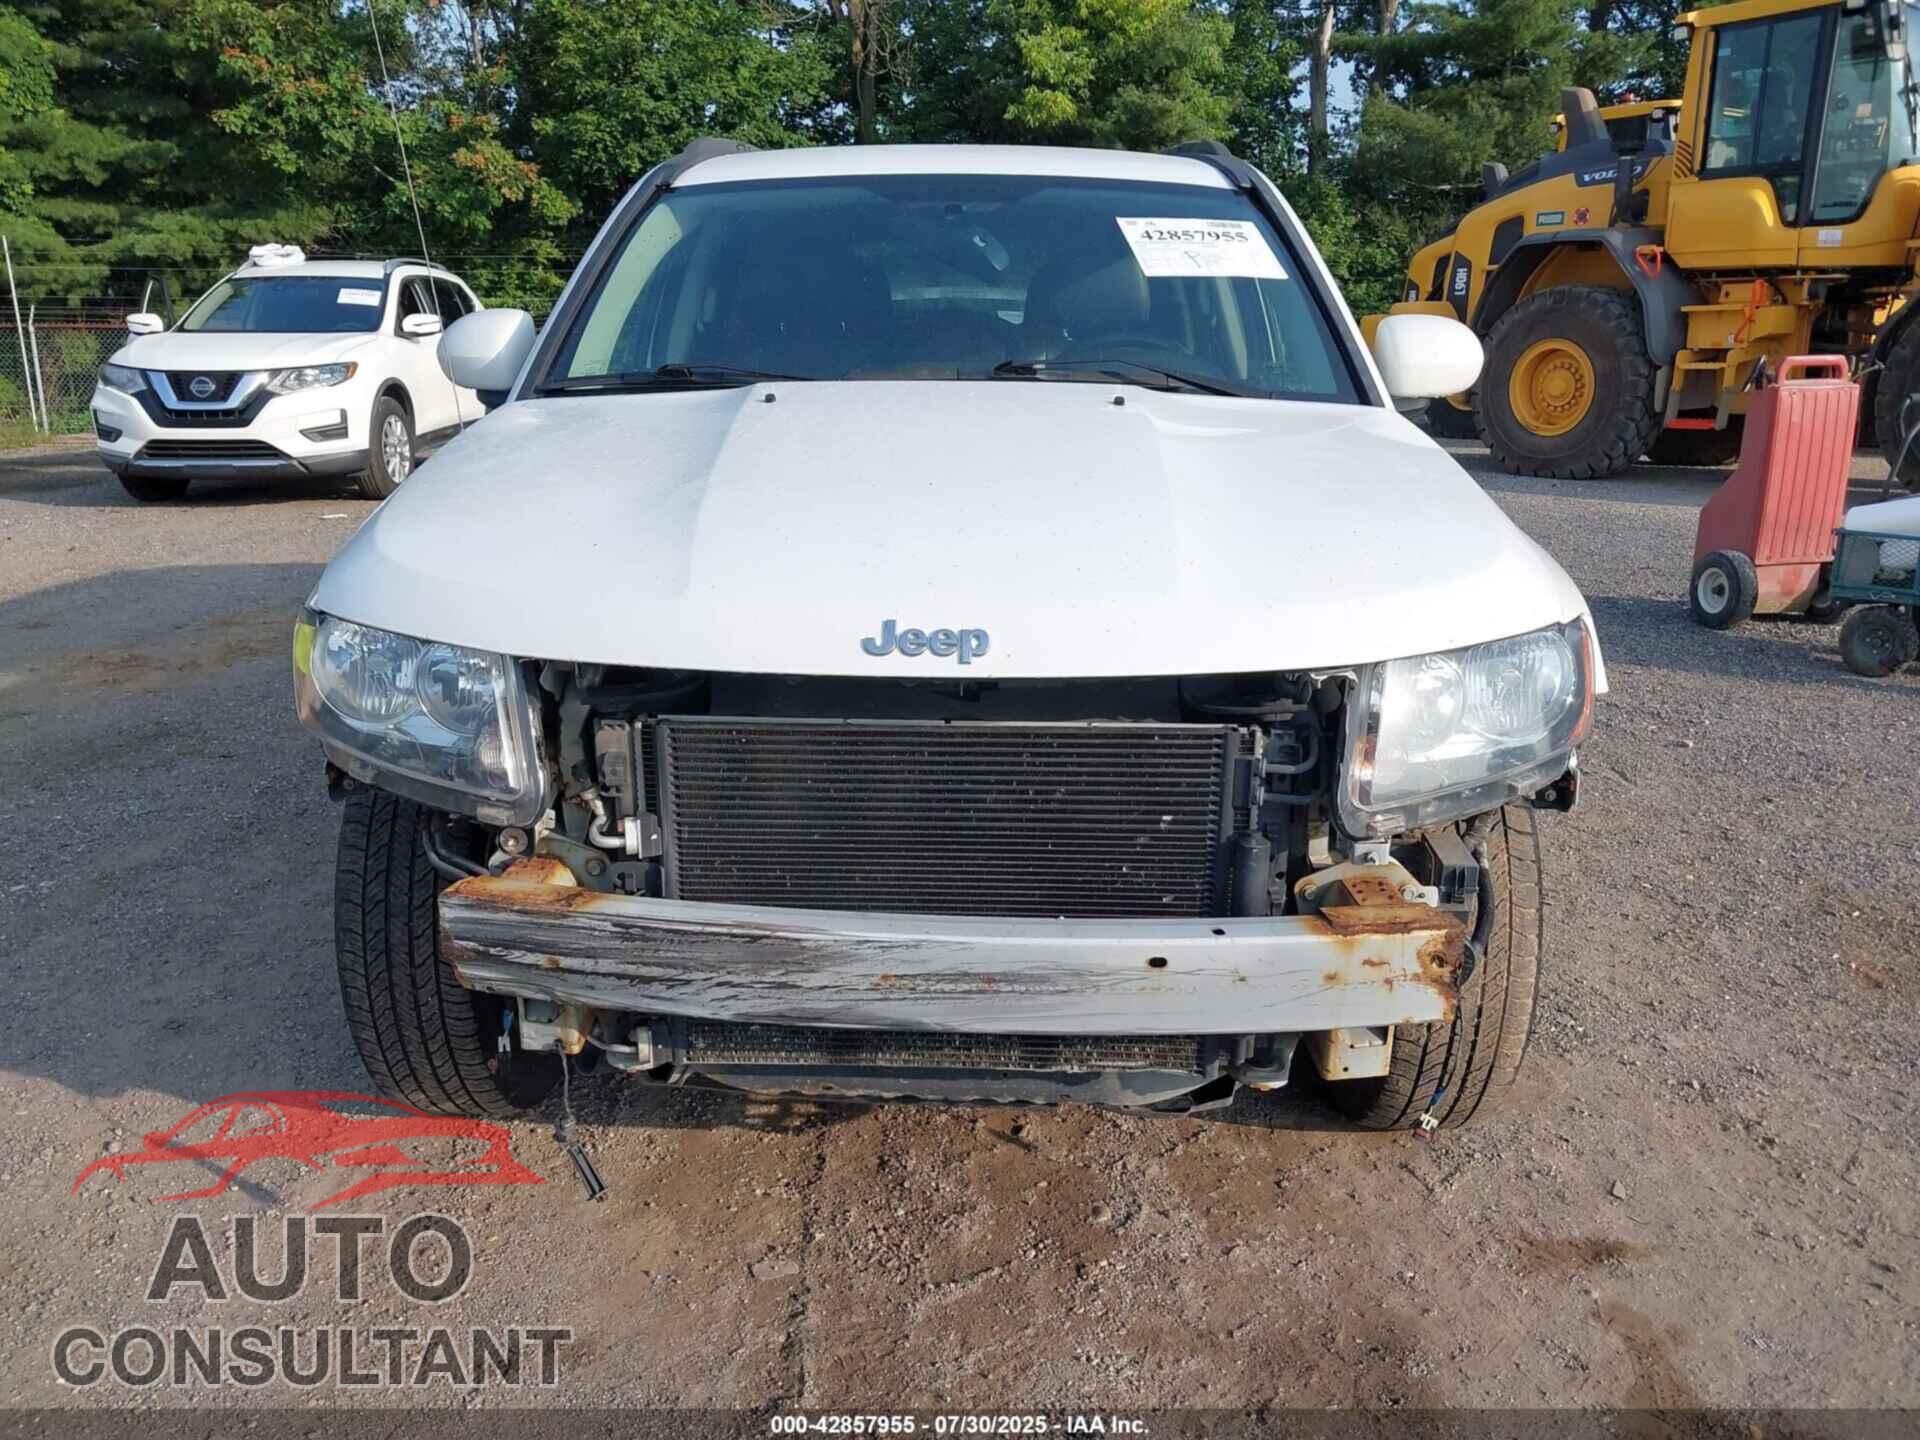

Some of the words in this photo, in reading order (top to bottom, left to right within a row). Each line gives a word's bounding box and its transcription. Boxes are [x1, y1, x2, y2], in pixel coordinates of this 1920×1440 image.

[1583, 165, 1643, 182] VOLO
[1140, 229, 1249, 243] 42857955
[1453, 267, 1468, 296] L90H
[861, 619, 990, 665] Jeep
